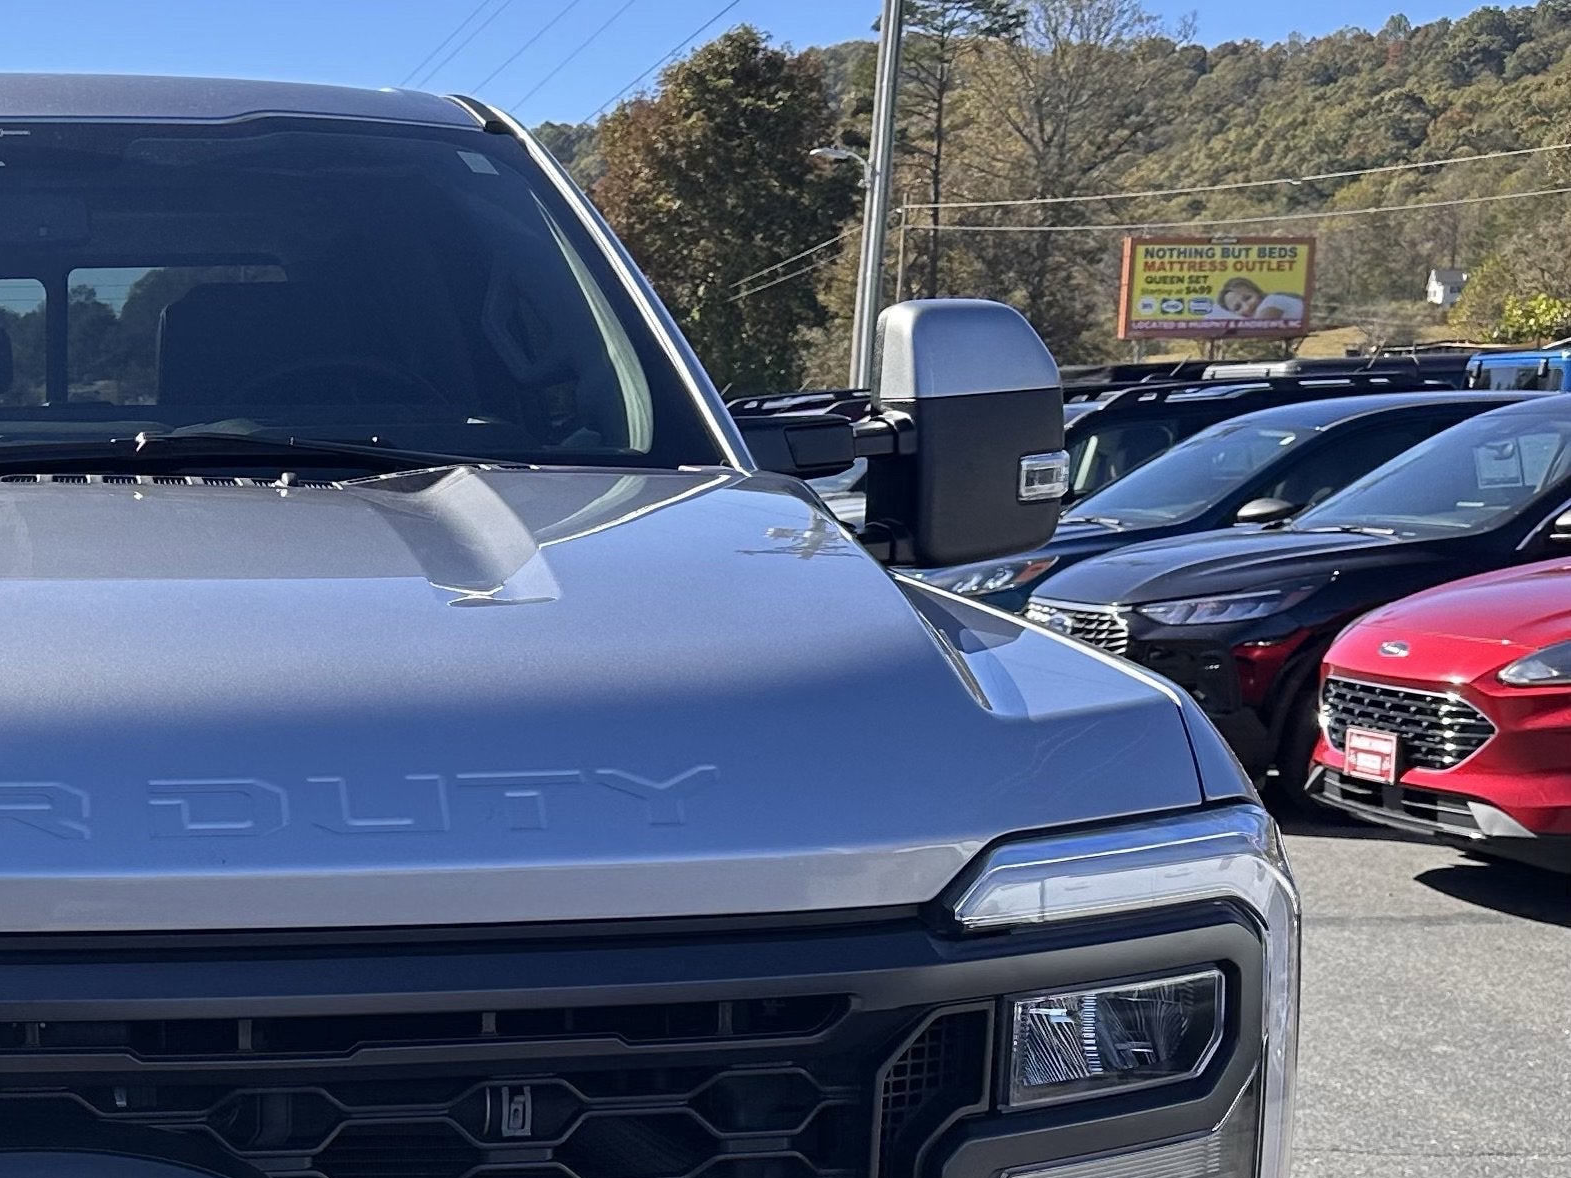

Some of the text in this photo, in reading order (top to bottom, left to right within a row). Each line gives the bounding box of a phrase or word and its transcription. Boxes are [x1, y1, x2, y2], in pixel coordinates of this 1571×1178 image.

[1144, 247, 1298, 260] NOTHING BUT BEDS
[1143, 260, 1297, 273] MATTRESS OUTLET
[1144, 275, 1209, 285] QUEEN SET
[1185, 285, 1213, 295] $499
[1132, 321, 1175, 330] LOCATED
[147, 766, 720, 838] DUTY
